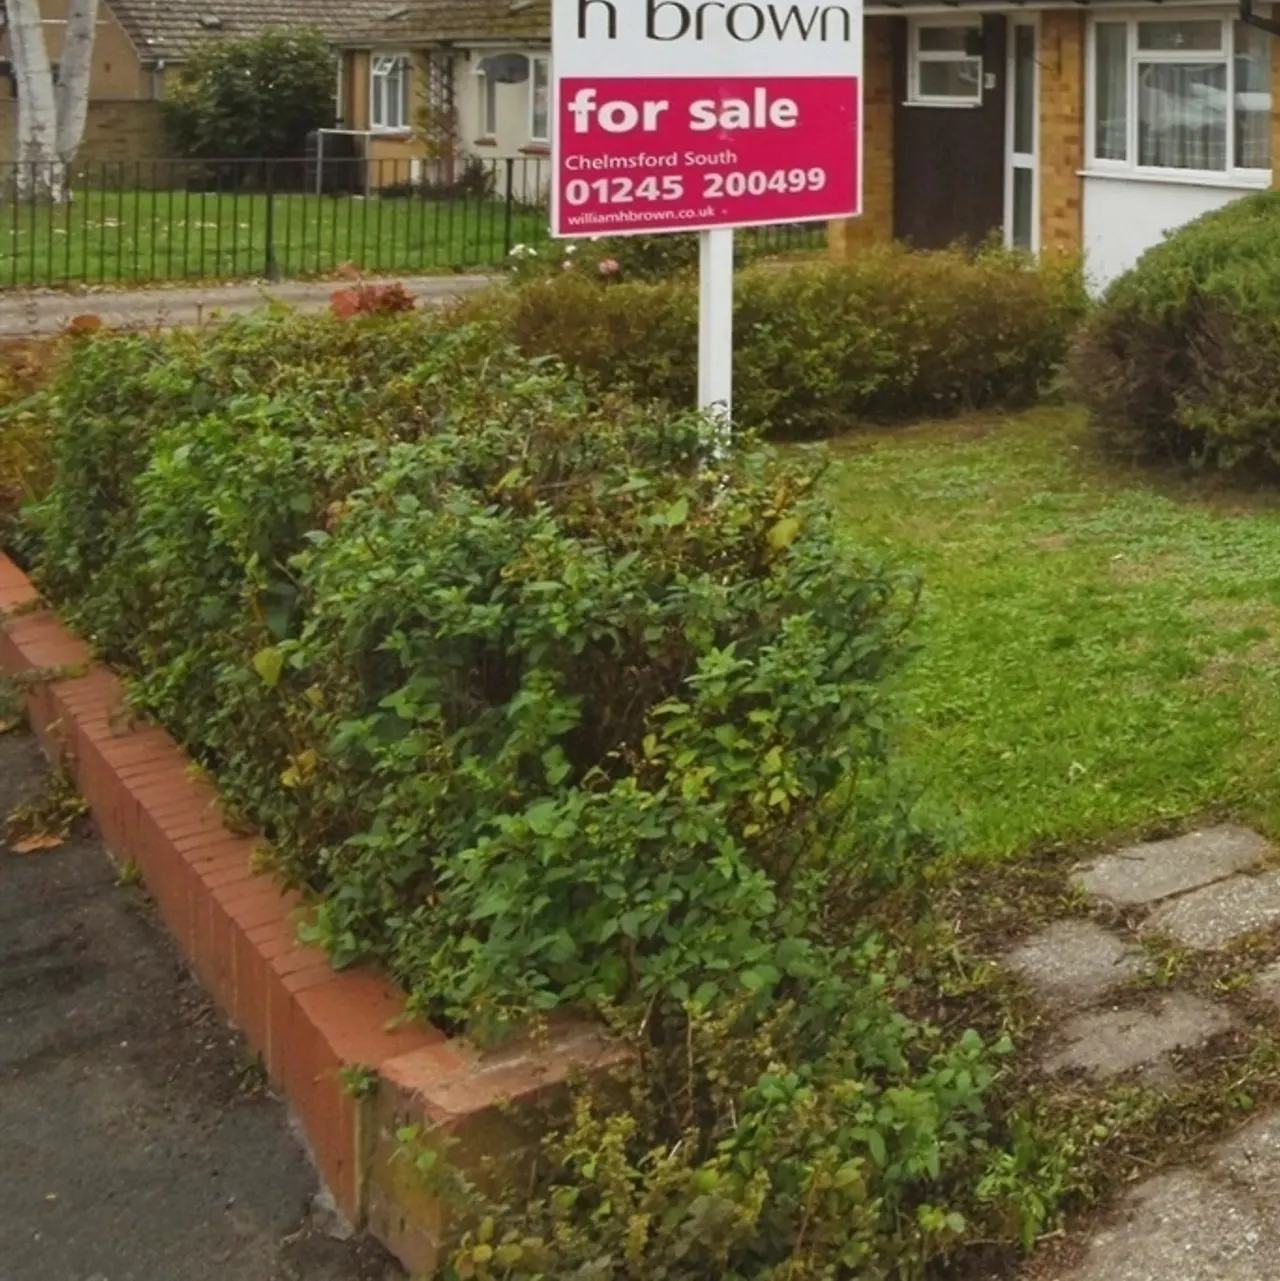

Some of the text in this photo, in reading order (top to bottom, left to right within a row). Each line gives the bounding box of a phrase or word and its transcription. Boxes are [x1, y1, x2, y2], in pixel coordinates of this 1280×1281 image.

[568, 87, 799, 133] for sale
[565, 150, 737, 170] Chelmsford South
[565, 167, 826, 205] 01245 200499
[568, 206, 715, 226] williamhbrown.co.uk
